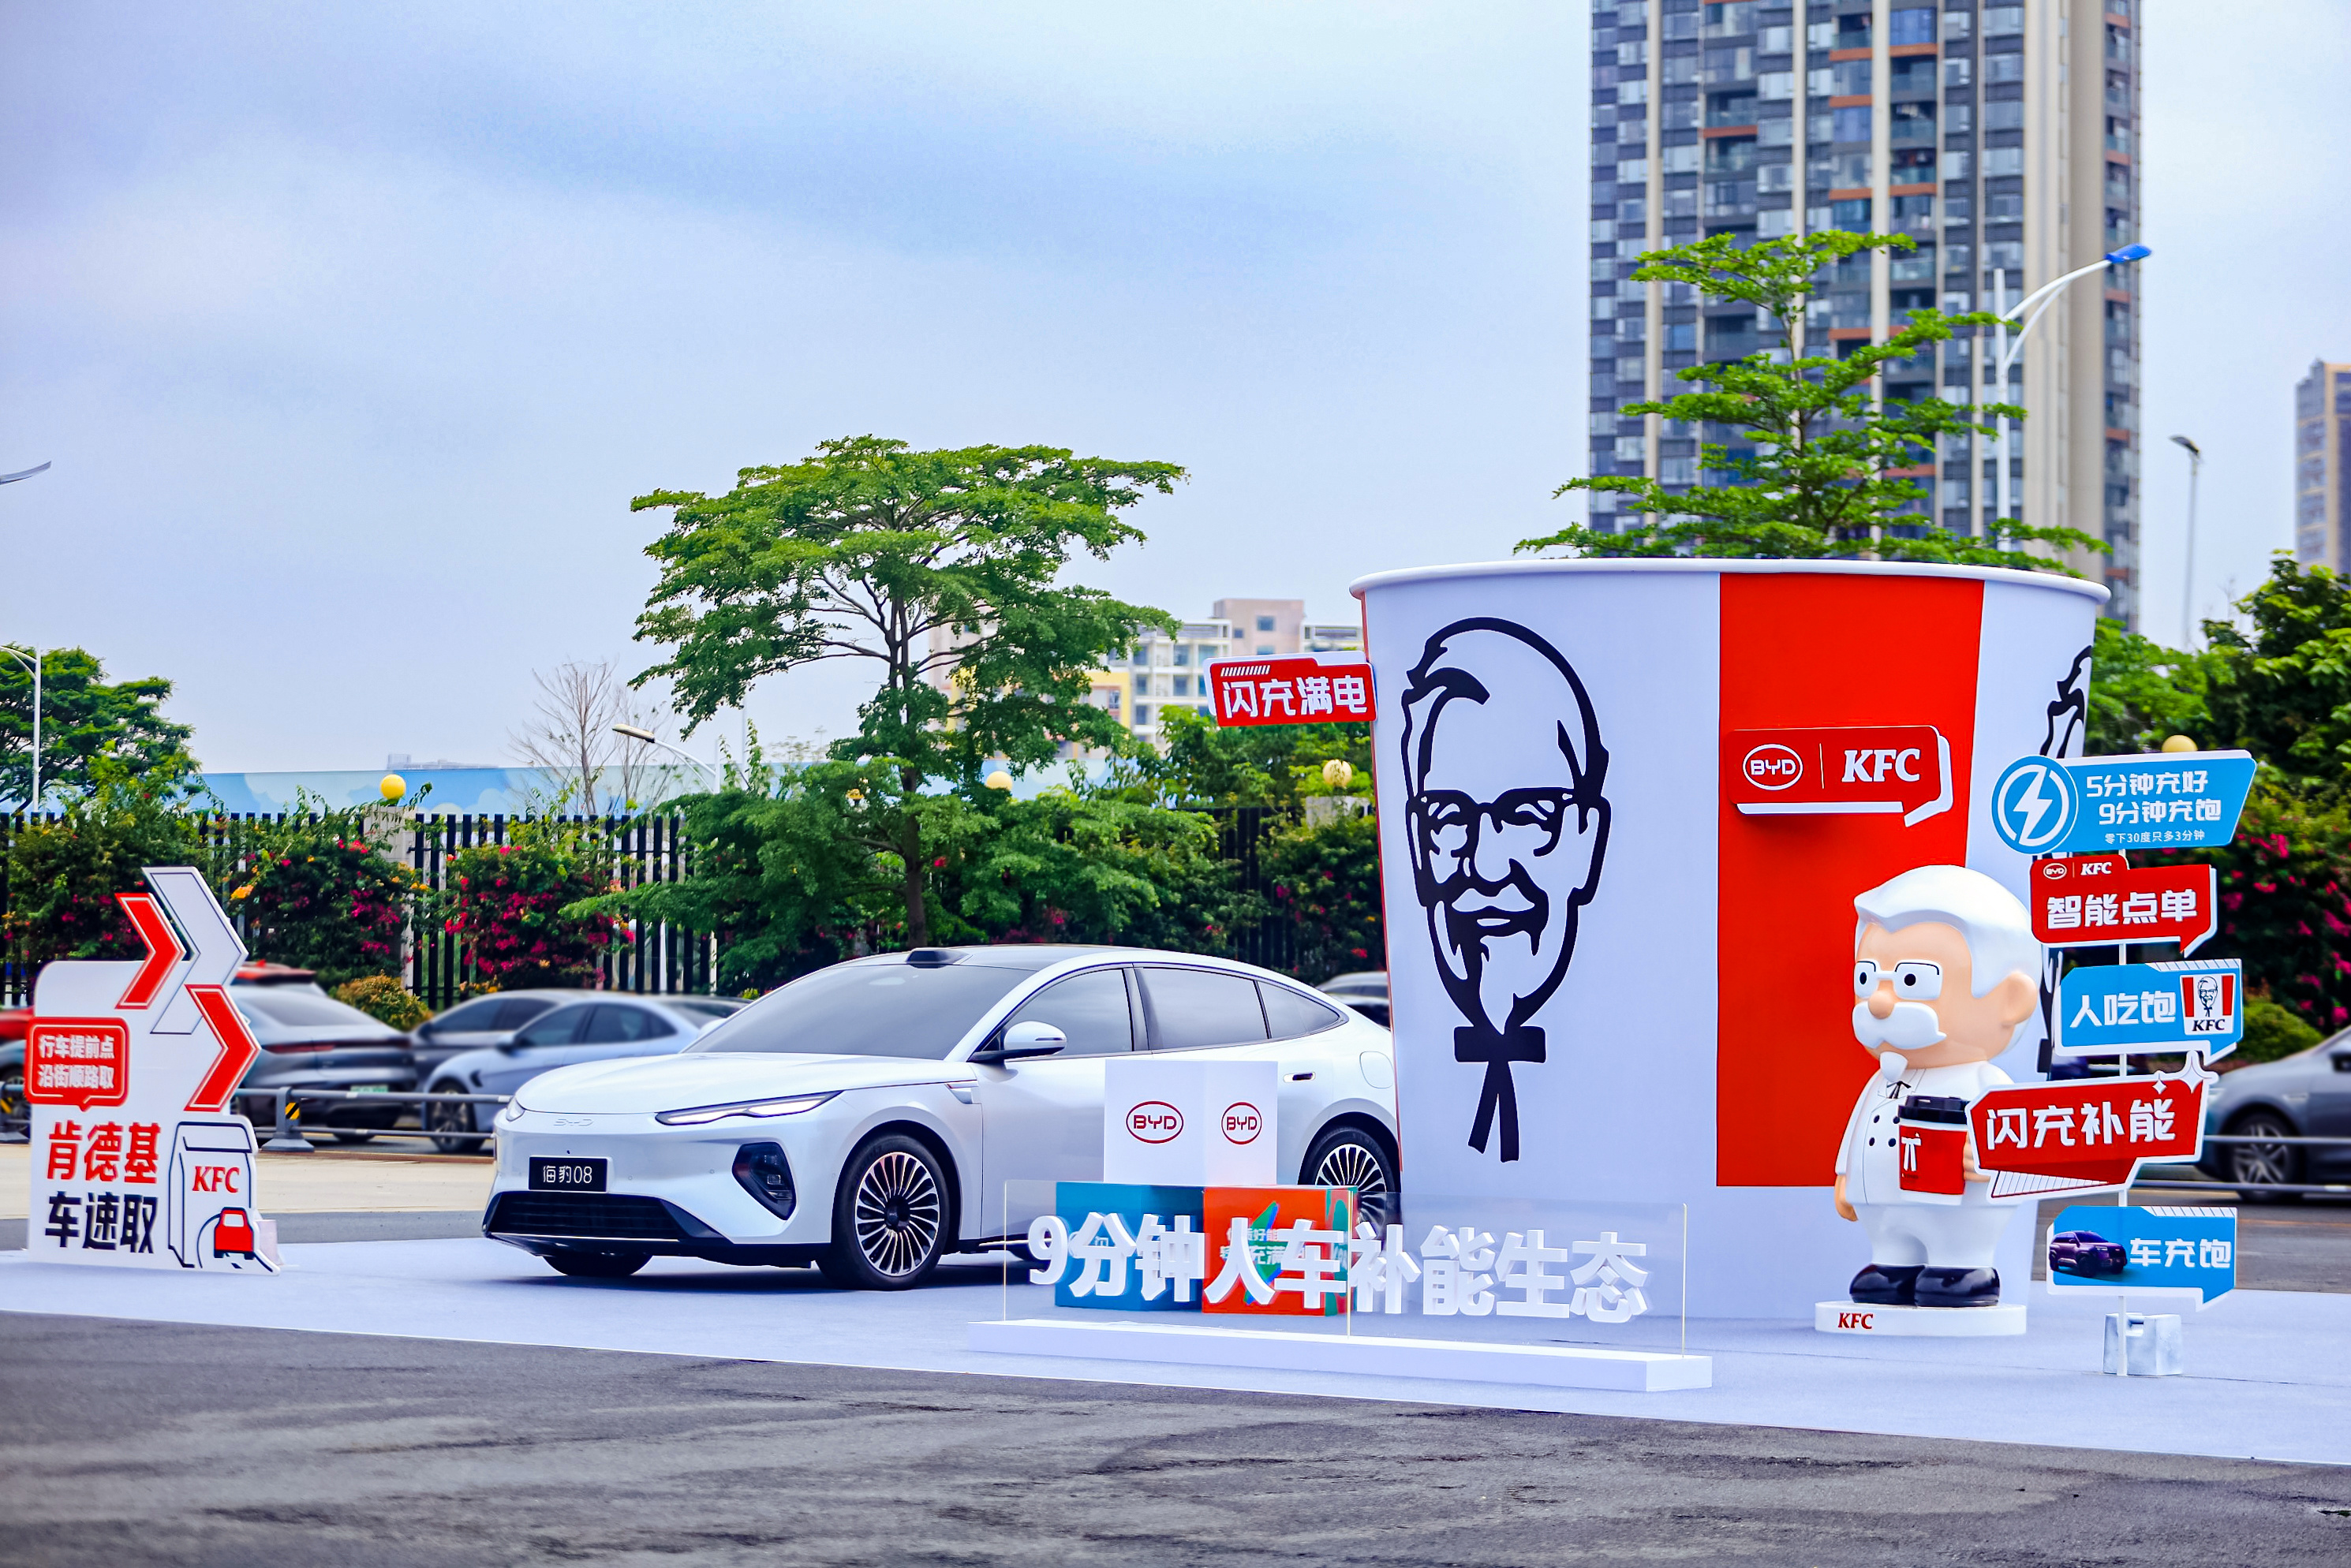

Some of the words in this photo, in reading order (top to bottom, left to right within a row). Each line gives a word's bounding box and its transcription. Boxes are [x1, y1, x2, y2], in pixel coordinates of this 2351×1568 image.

[1223, 675, 1367, 718] 闪充满电
[1750, 759, 1796, 775] BYD
[1841, 748, 1920, 782] KFC
[2086, 770, 2208, 797] 5分钟充好
[2099, 798, 2222, 825] 9分钟充饱
[2104, 829, 2205, 845] 零下30度只多3分钟
[2080, 861, 2113, 876] KFC
[2046, 888, 2197, 930] 智能点单
[2069, 990, 2177, 1029] 人吃饱
[2192, 1018, 2226, 1032] KFC
[38, 1034, 115, 1058] 行车提前点
[37, 1064, 115, 1089] 沿街顺路取
[1133, 1114, 1177, 1129] BYD
[1226, 1116, 1258, 1130] BYD
[1985, 1098, 2177, 1151] 闪充补能
[47, 1119, 162, 1184] 肯德基
[192, 1165, 241, 1193] KFC
[543, 1165, 592, 1184] 海豹08
[45, 1191, 158, 1254] 车速取
[2129, 1238, 2232, 1268] 车充饱
[1028, 1211, 1650, 1324] 9分钟人车补能生态
[1837, 1312, 1874, 1330] KFC
